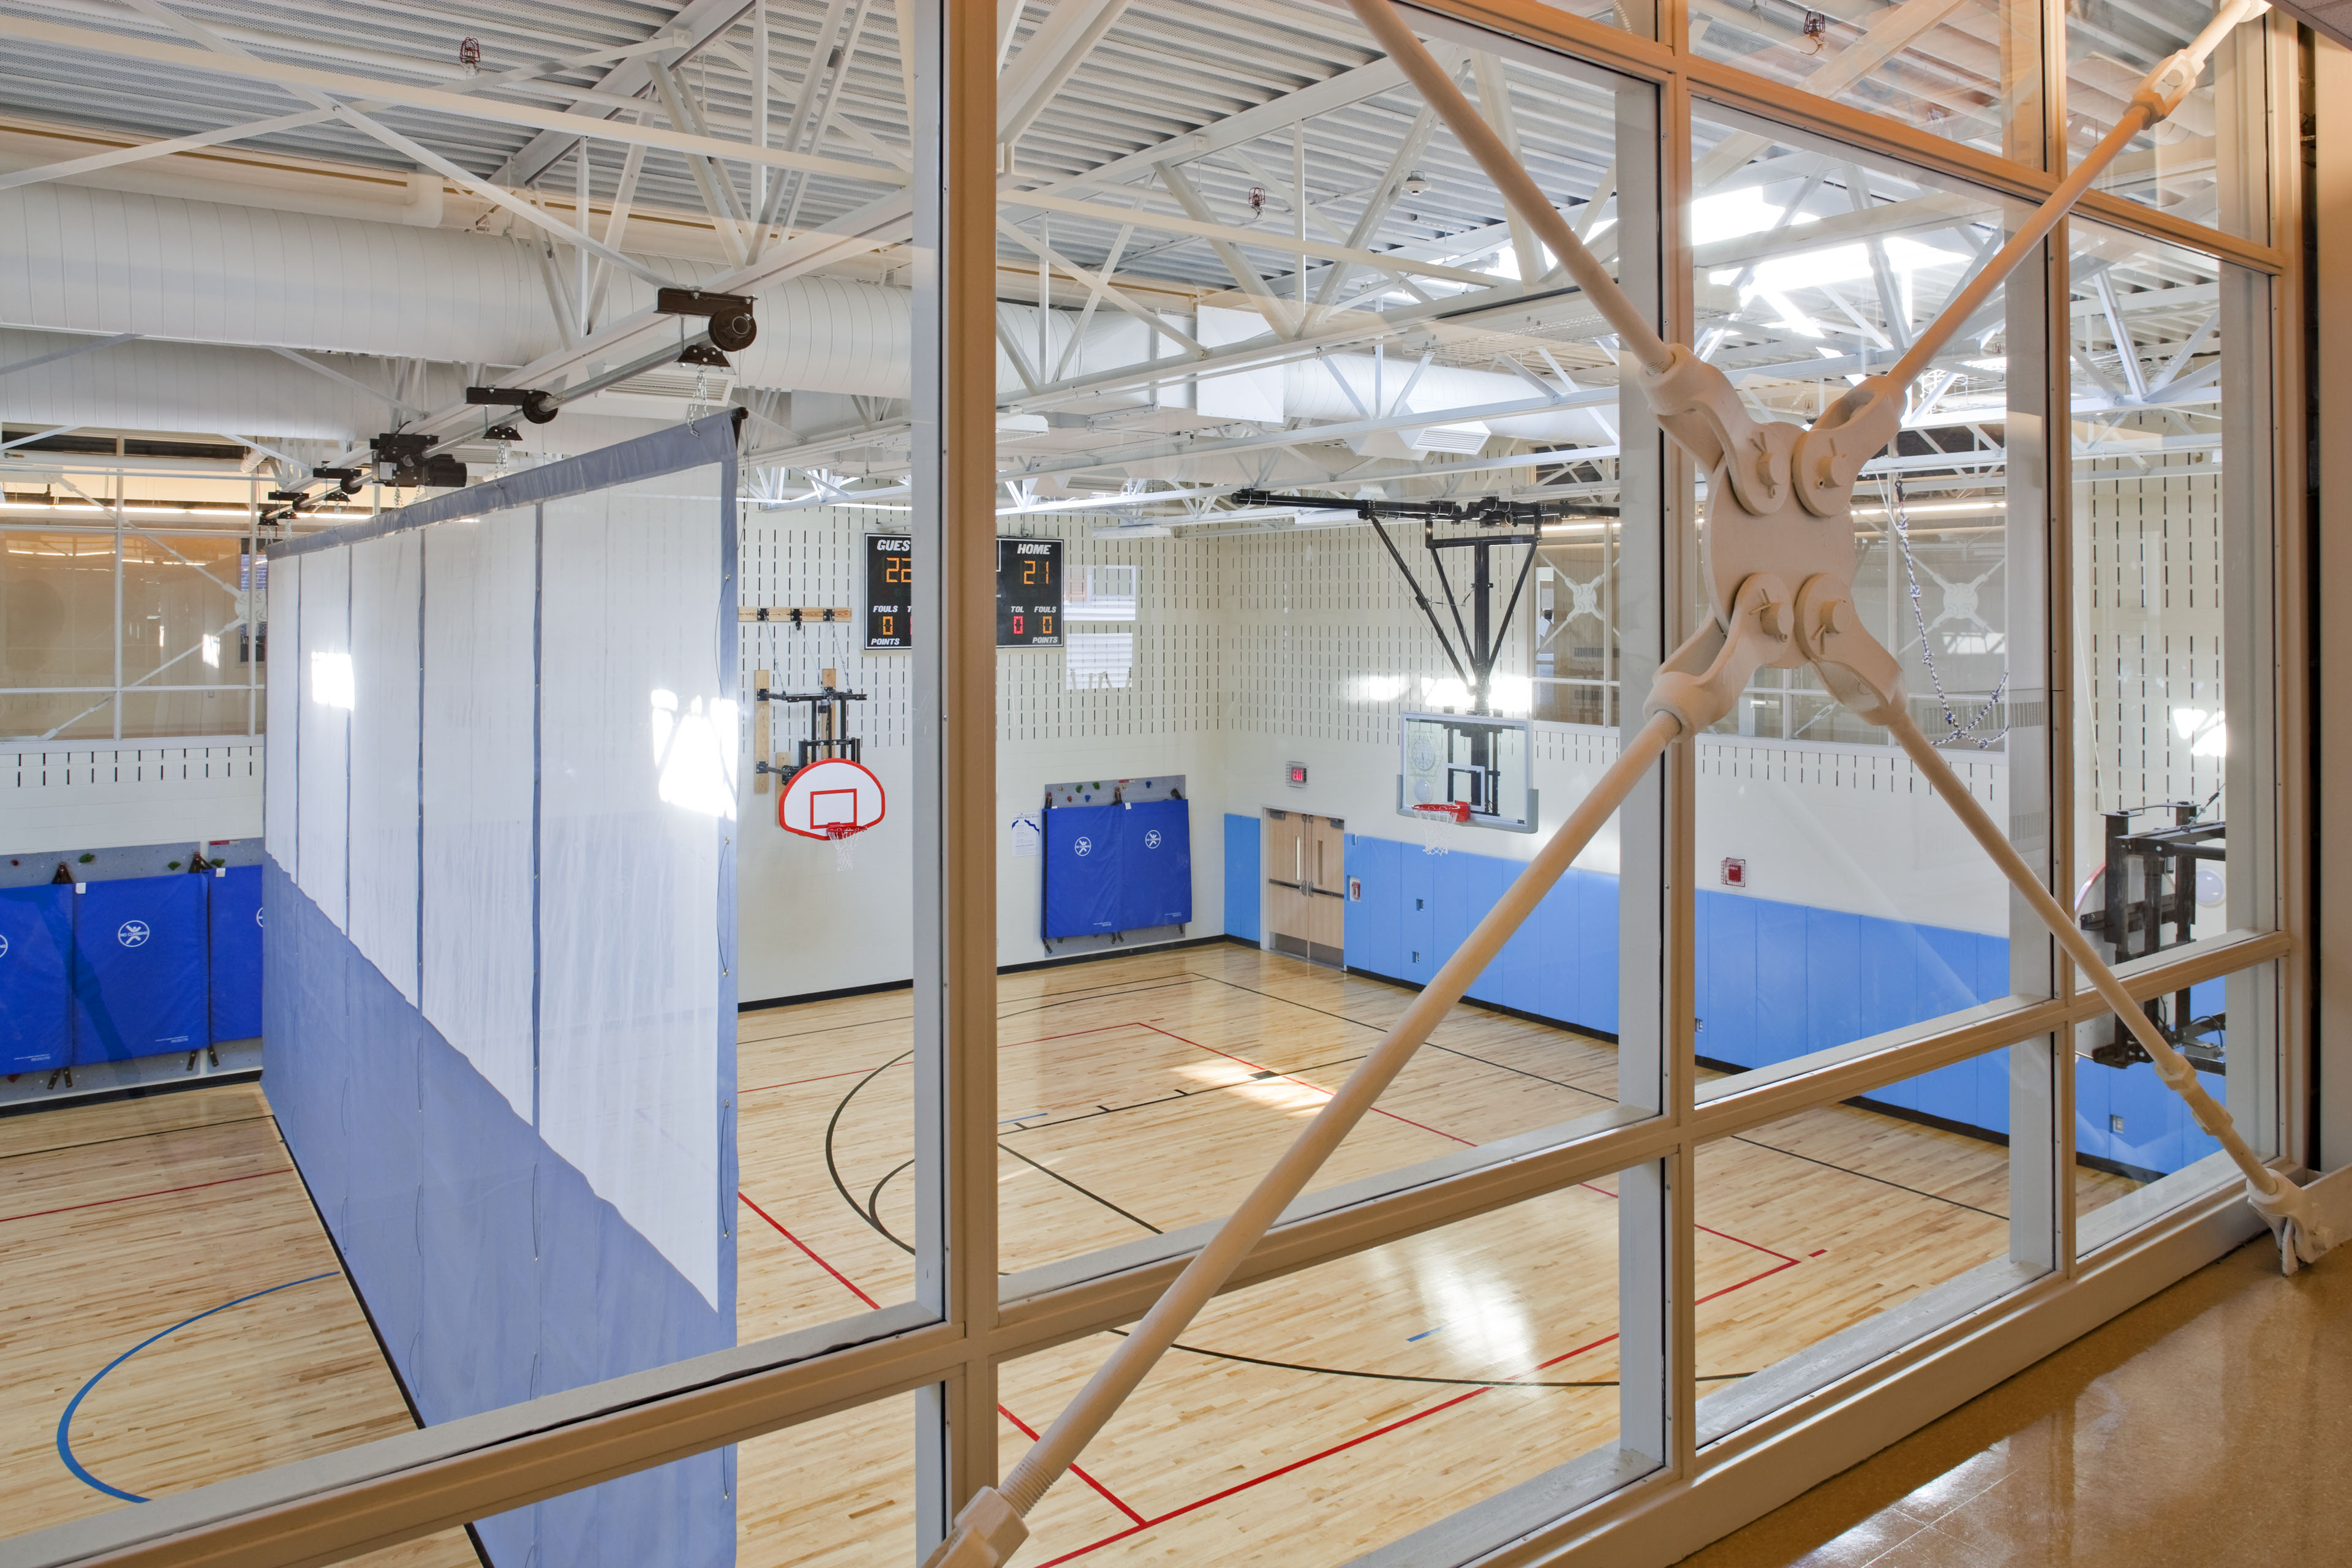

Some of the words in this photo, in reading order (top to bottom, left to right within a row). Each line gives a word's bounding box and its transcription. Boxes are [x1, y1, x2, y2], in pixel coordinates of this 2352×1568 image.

[877, 540, 911, 551] GUES
[1017, 543, 1052, 555] HOME
[1023, 560, 1049, 585] 21
[883, 616, 894, 635] 0
[1013, 616, 1023, 635] 0
[1042, 616, 1053, 635] 0
